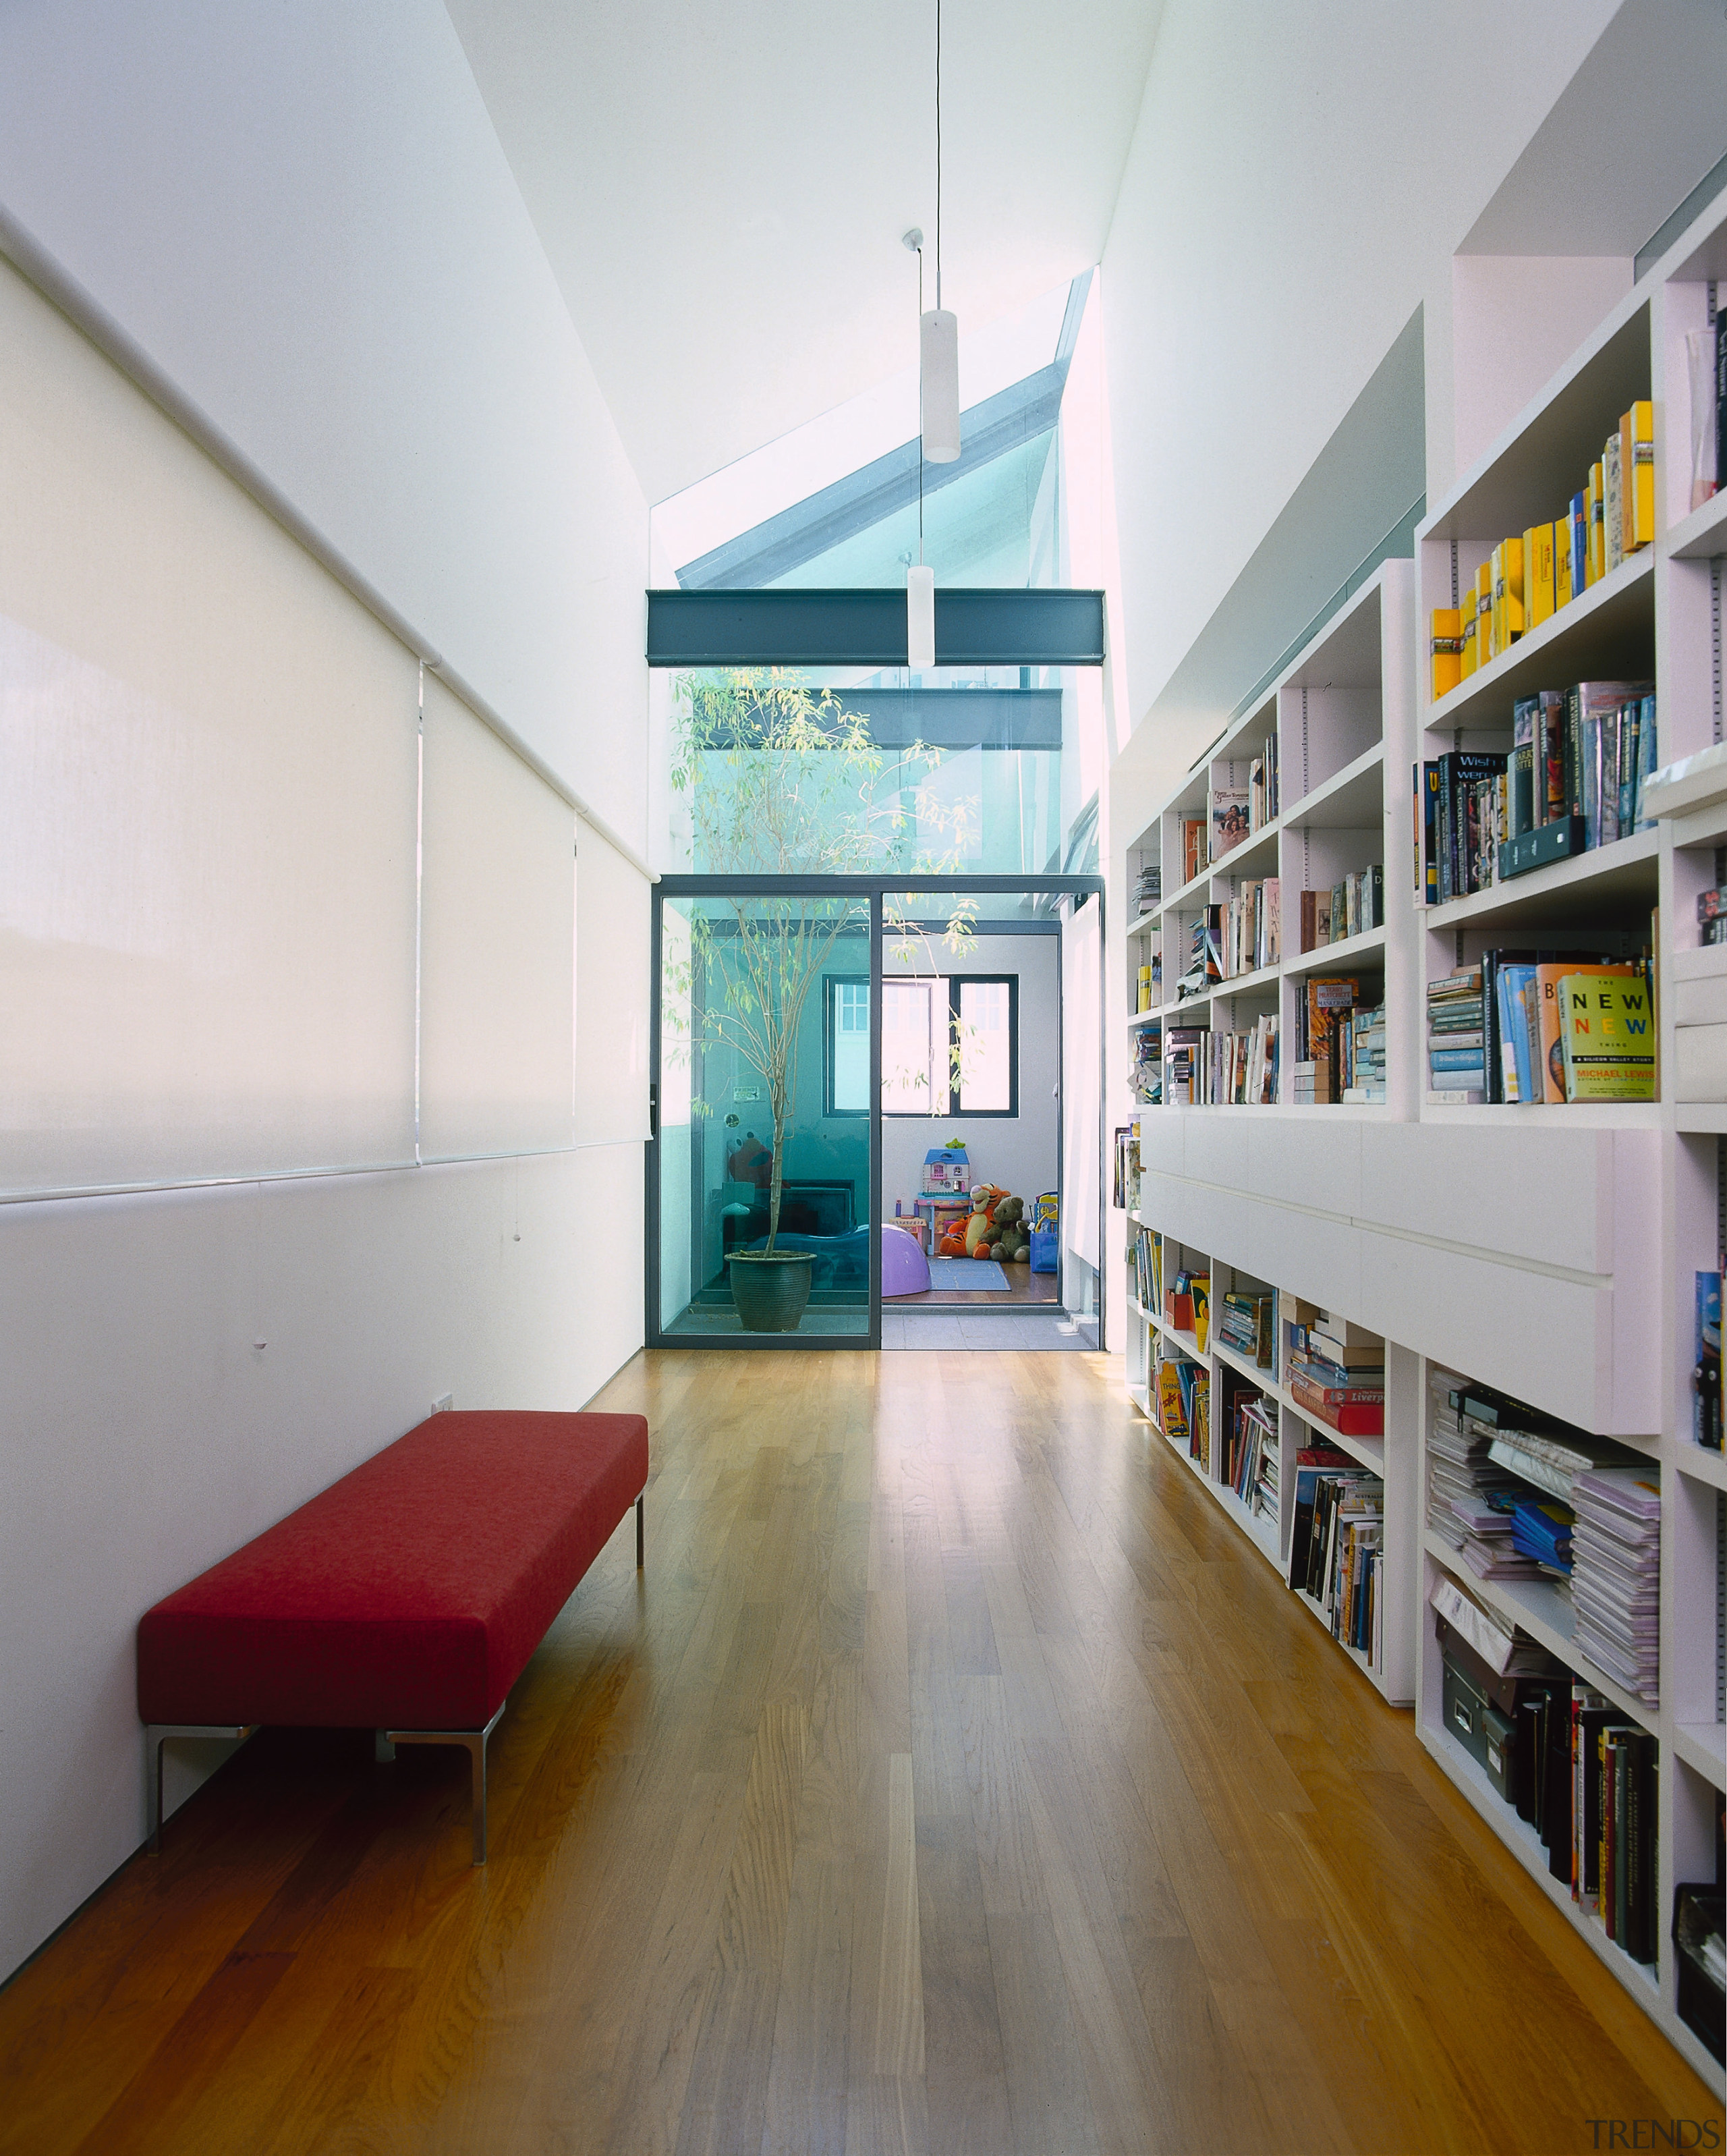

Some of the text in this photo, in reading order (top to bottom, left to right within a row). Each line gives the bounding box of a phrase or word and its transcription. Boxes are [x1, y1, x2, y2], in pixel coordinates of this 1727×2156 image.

[1460, 756, 1496, 767] Wish
[1573, 993, 1643, 1010] NEW
[1575, 1018, 1647, 1034] NEW
[1577, 1070, 1655, 1078] MICHAEL LEWIS
[1351, 1392, 1384, 1404] Liverp
